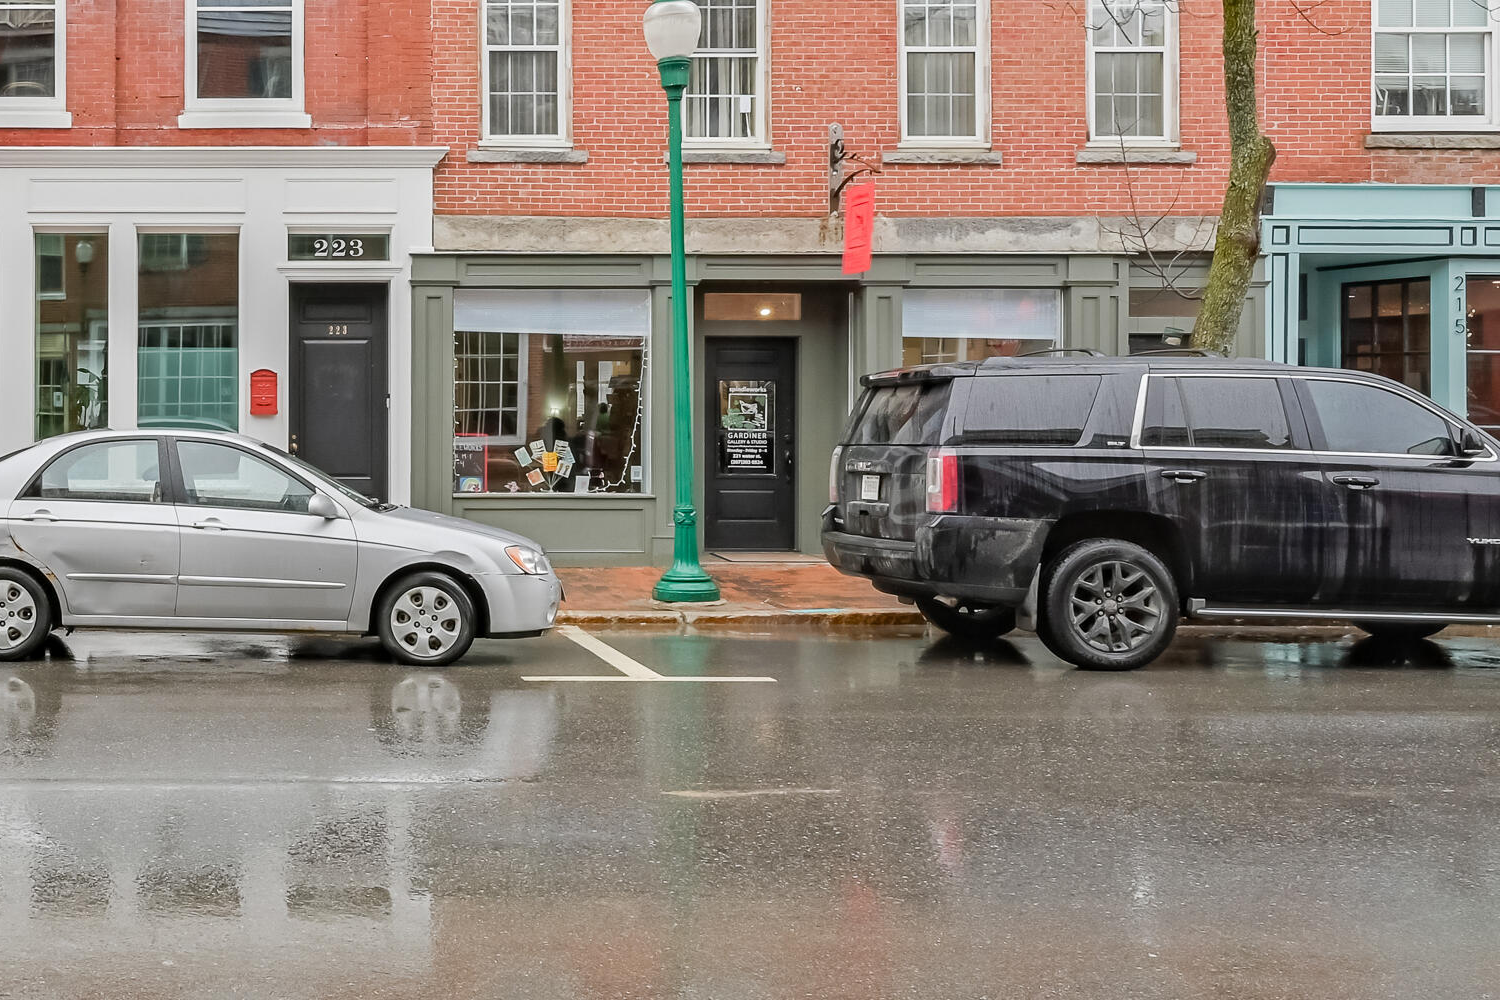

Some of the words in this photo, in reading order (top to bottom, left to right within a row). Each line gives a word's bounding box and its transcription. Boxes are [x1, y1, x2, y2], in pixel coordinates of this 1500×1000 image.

[313, 238, 364, 257] 223
[1454, 275, 1465, 334] 215
[328, 325, 348, 335] 223
